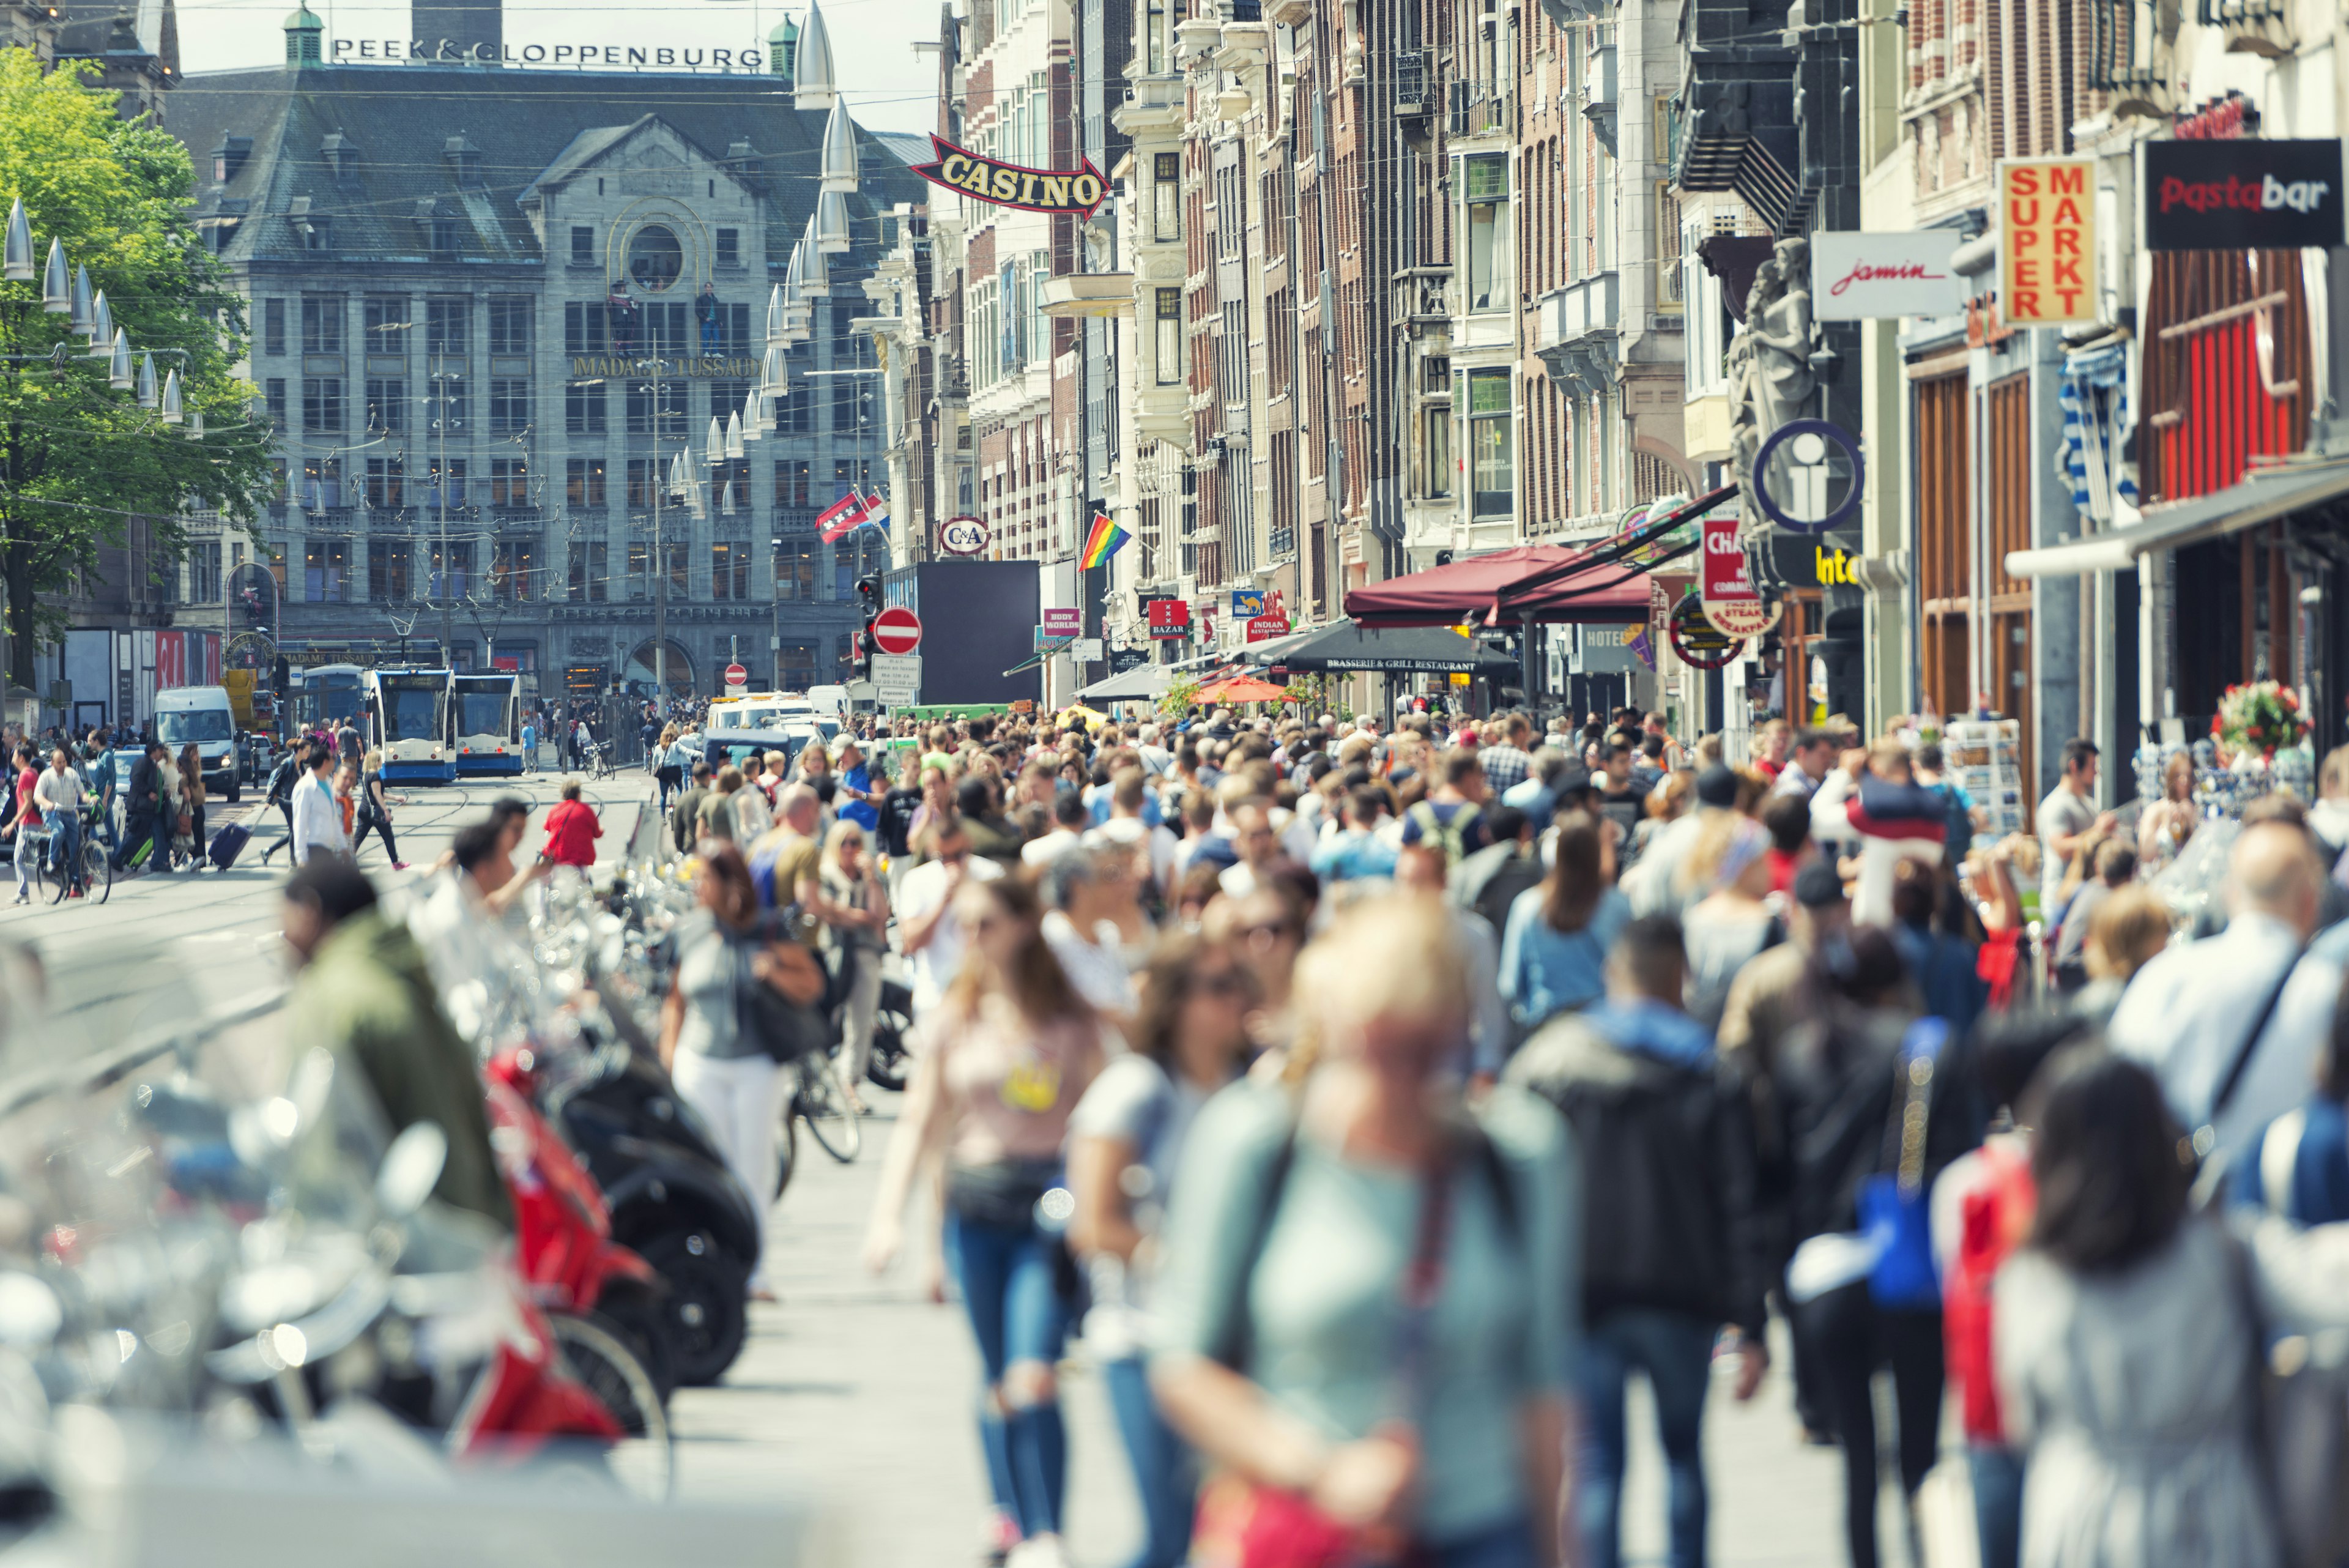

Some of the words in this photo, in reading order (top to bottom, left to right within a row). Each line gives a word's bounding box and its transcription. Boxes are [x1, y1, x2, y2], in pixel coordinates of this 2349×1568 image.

[334, 39, 428, 59] PEEK
[437, 38, 465, 60] &
[472, 42, 762, 67] CLOPPENBURG
[942, 154, 1101, 206] CASINO
[2010, 167, 2041, 318] SUPER
[2050, 166, 2084, 316] MARKT
[1830, 258, 1946, 296] jamin
[948, 527, 982, 544] C&A
[1712, 611, 1770, 633] BREAKFAS
[1587, 631, 1627, 646] HOTEL
[283, 653, 325, 663] MADAME
[331, 654, 375, 664] TUSSAUD
[1327, 659, 1375, 668] BRASSERIE
[1385, 660, 1413, 668] GRILL
[1416, 660, 1475, 671] RESTAURANT
[387, 676, 392, 686] 4
